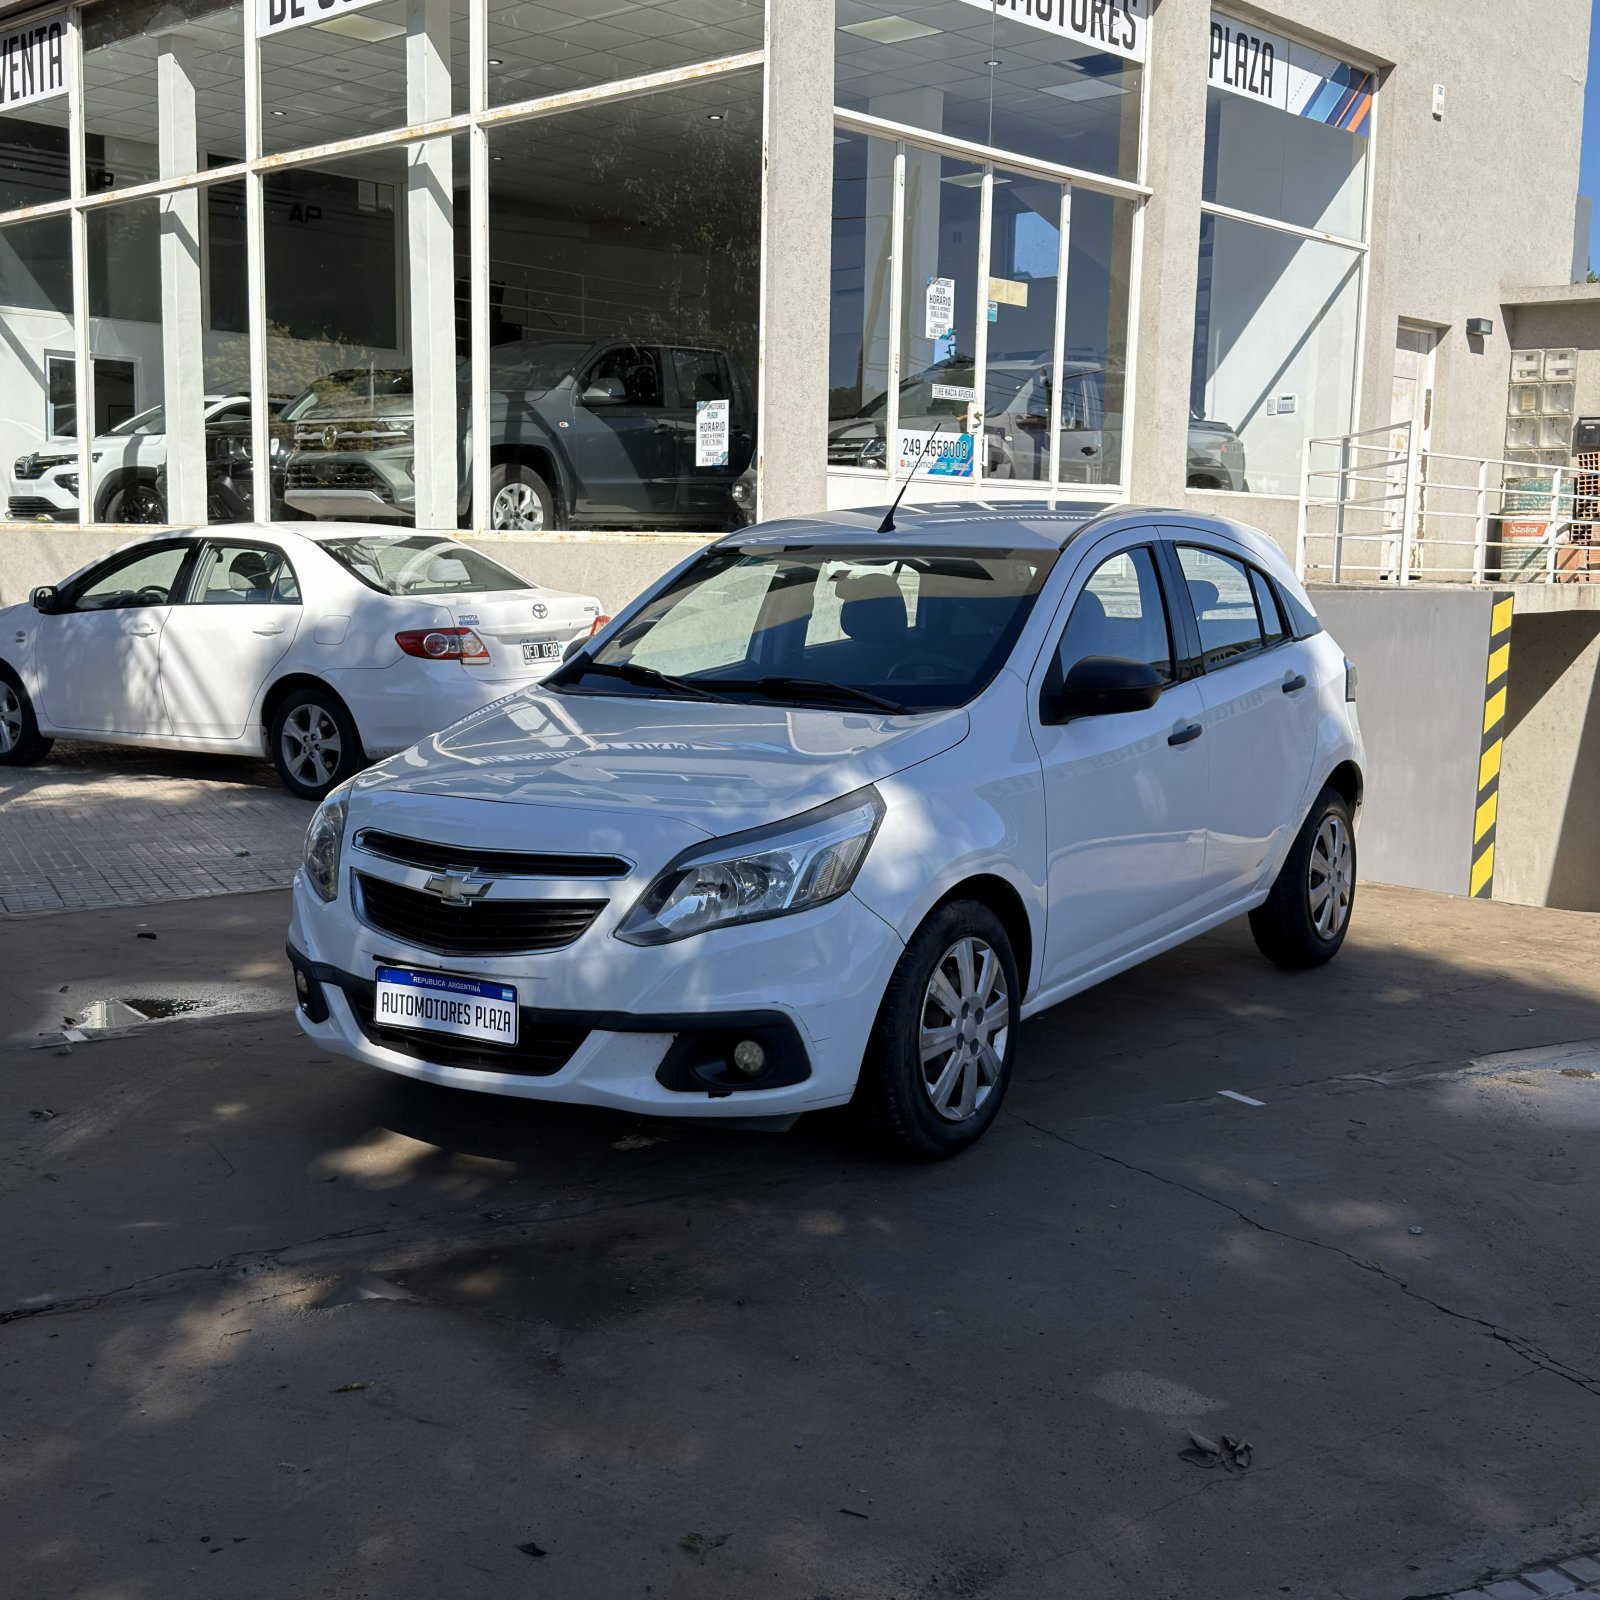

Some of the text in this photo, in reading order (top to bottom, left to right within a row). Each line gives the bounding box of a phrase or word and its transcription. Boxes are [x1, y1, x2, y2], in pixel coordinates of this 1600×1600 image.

[991, 0, 1274, 98] ORES PLAZA
[930, 294, 951, 306] HORARIO
[958, 389, 974, 399] AFUERA
[700, 421, 725, 432] HORARIO
[903, 438, 967, 459] 249 4658008
[524, 642, 558, 659] NED 038
[413, 976, 481, 993] REPUBLICA ARGENTINA
[381, 991, 511, 1033] AUTOMOTORES PLAZA
